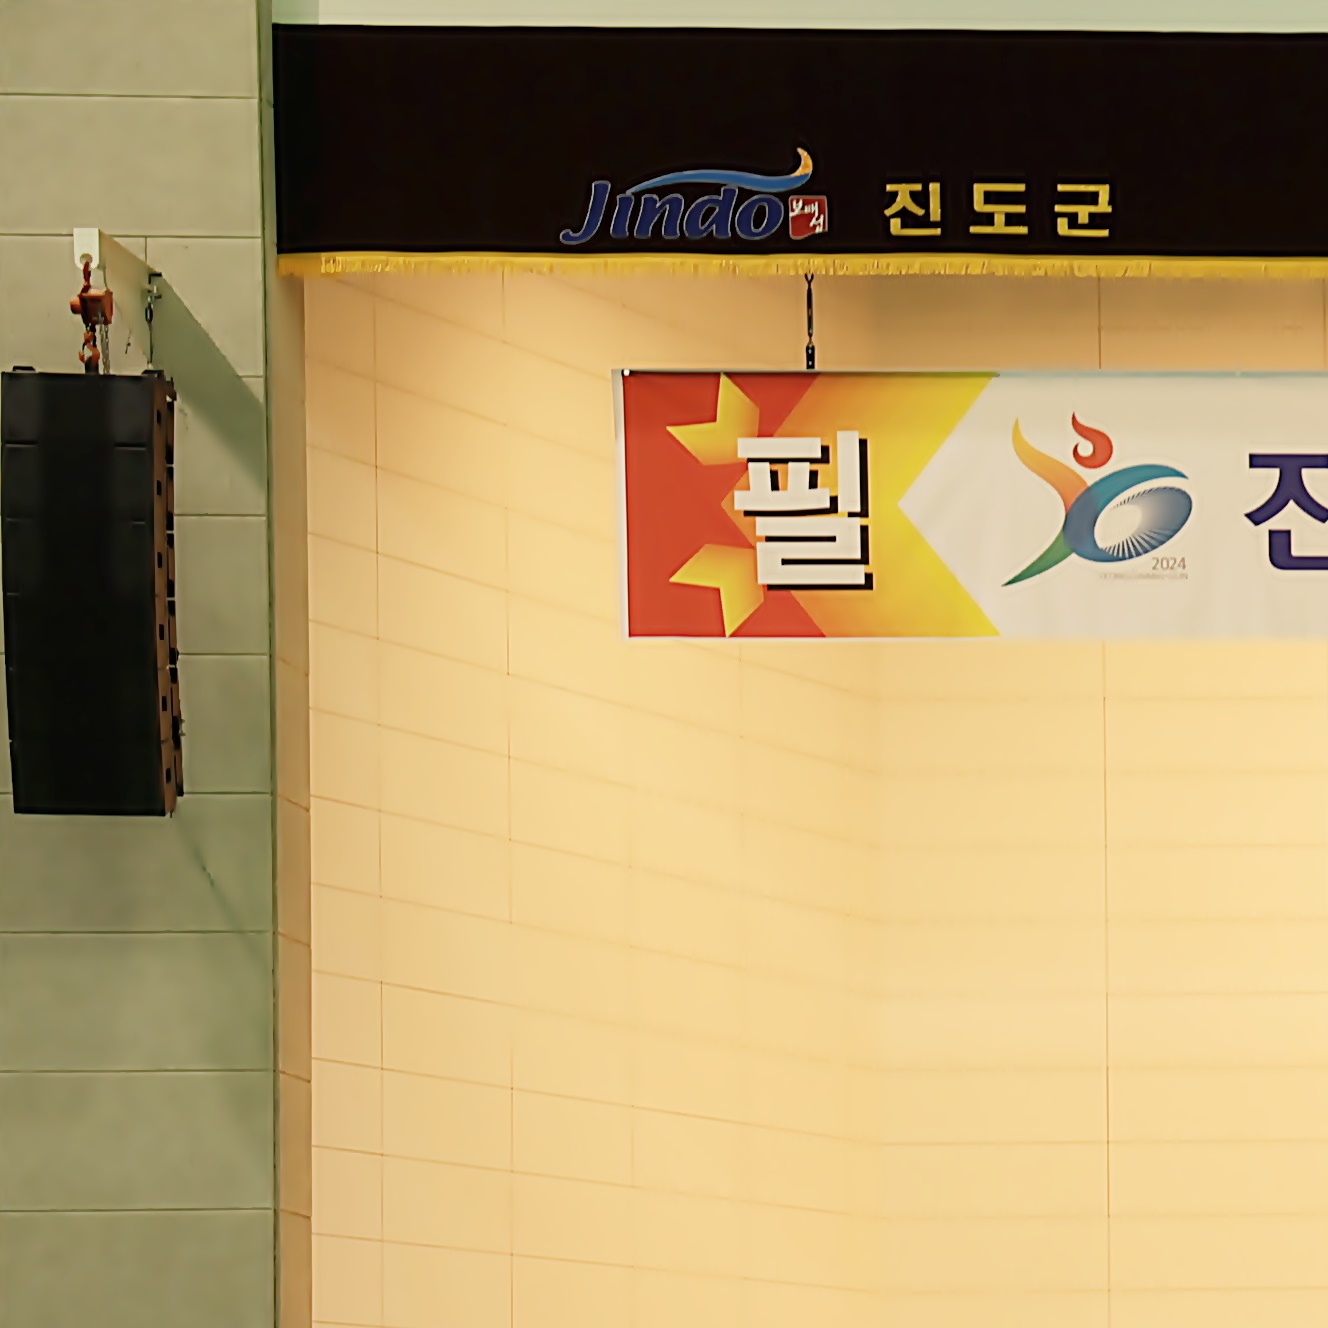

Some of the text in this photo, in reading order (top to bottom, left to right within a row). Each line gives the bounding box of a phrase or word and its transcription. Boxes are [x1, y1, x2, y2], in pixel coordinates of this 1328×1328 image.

[559, 180, 785, 246] Jindo
[883, 182, 1113, 238] 진도군
[733, 430, 873, 591] 필
[1151, 556, 1187, 571] 2024
